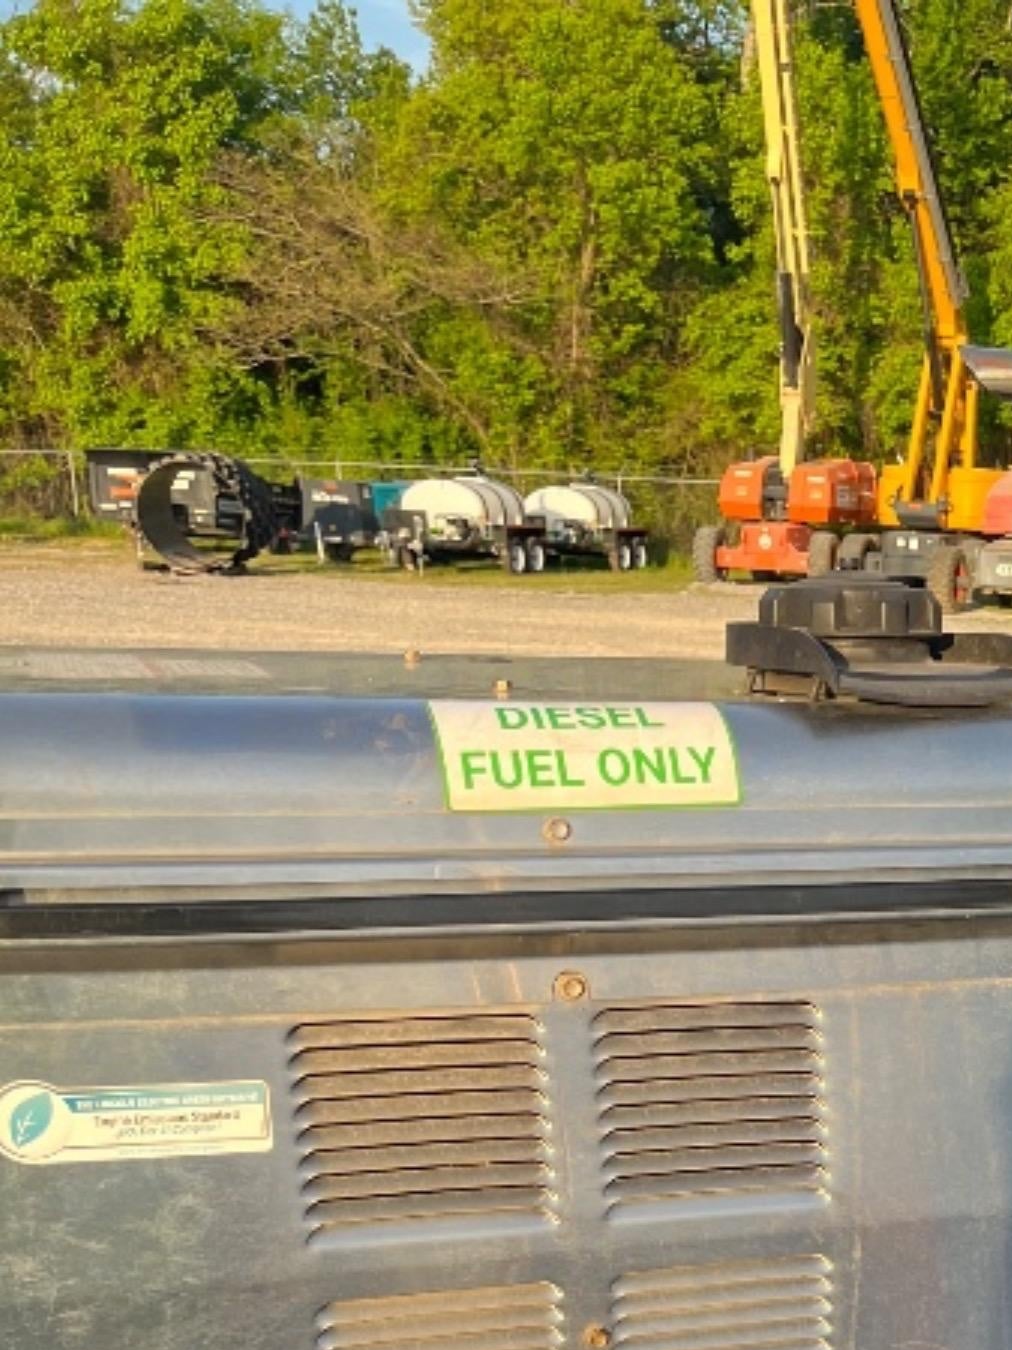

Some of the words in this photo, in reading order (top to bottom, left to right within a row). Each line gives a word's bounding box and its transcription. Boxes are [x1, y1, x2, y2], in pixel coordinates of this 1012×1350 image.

[495, 706, 665, 730] DIESEL
[460, 749, 585, 789] FUEL
[598, 747, 716, 786] ONLY
